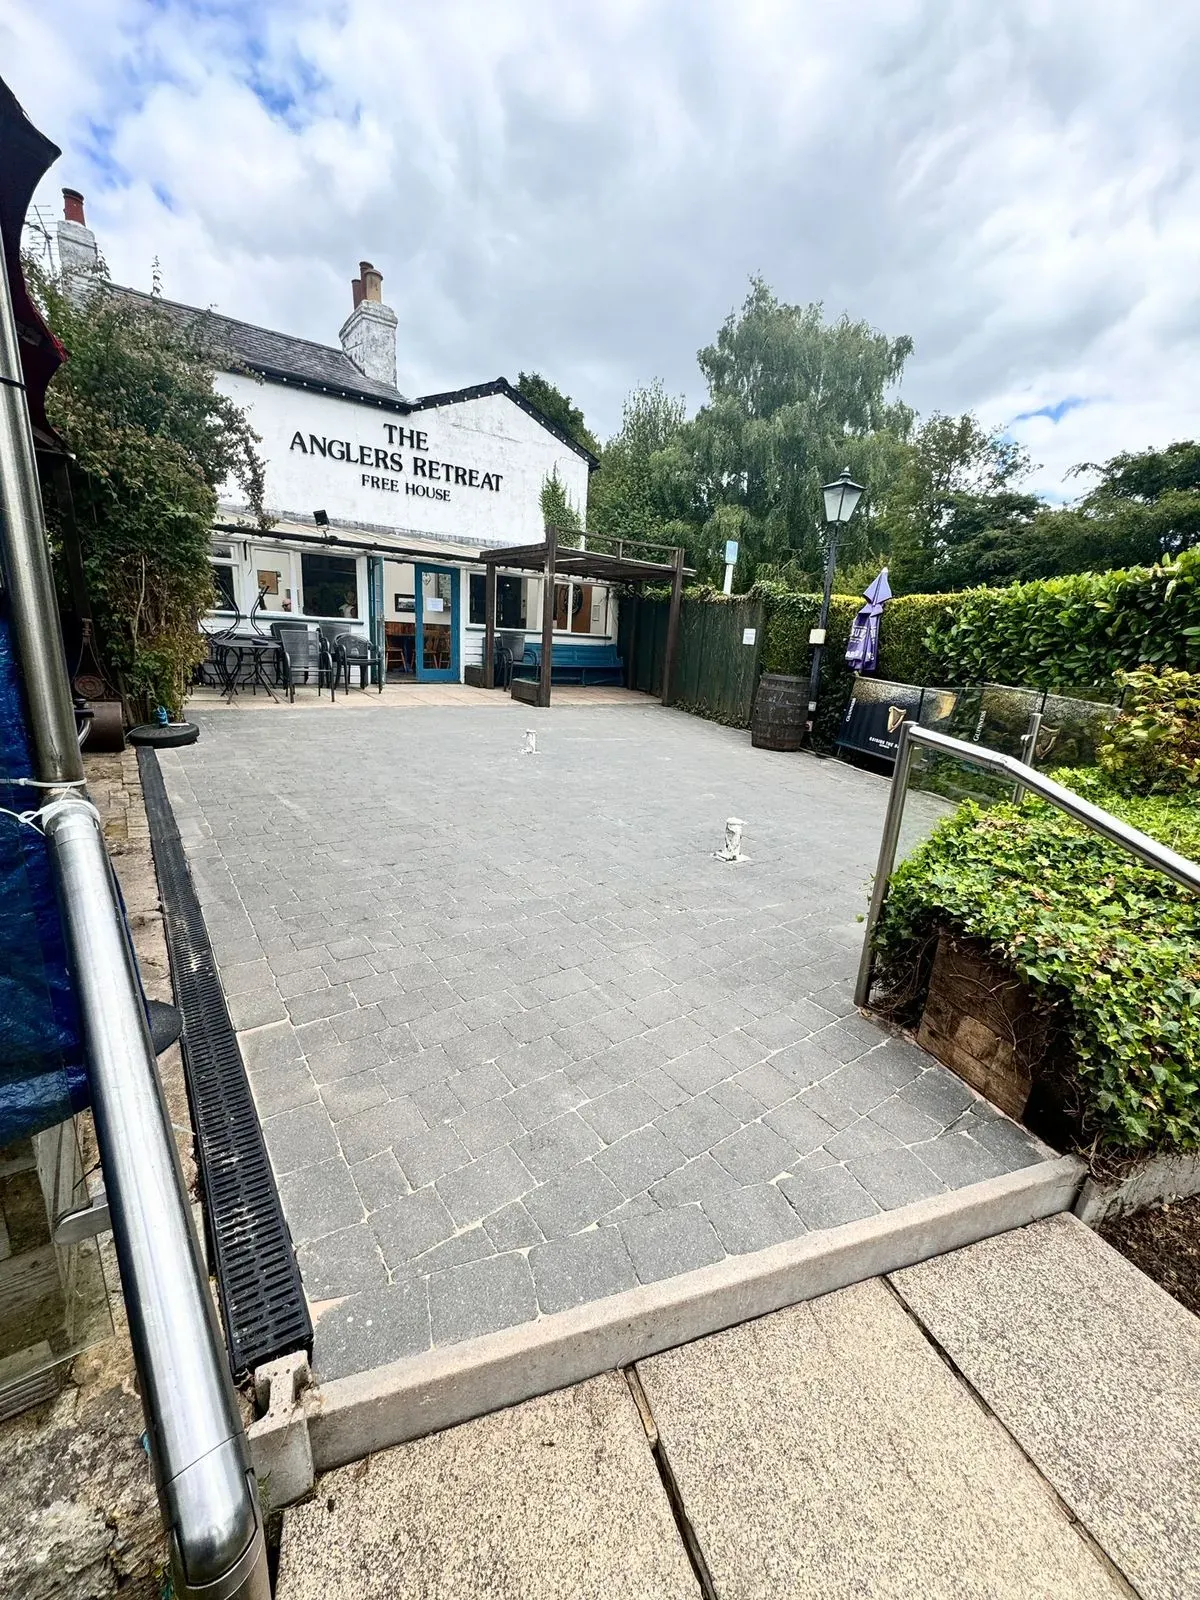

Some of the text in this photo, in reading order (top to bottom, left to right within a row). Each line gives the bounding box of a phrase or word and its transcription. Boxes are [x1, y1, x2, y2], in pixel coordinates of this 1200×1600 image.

[383, 423, 429, 451] THE
[289, 431, 503, 492] ANGLERS RETREAT
[361, 473, 451, 502] FREE HOUSE
[972, 710, 987, 742] GUINNESS
